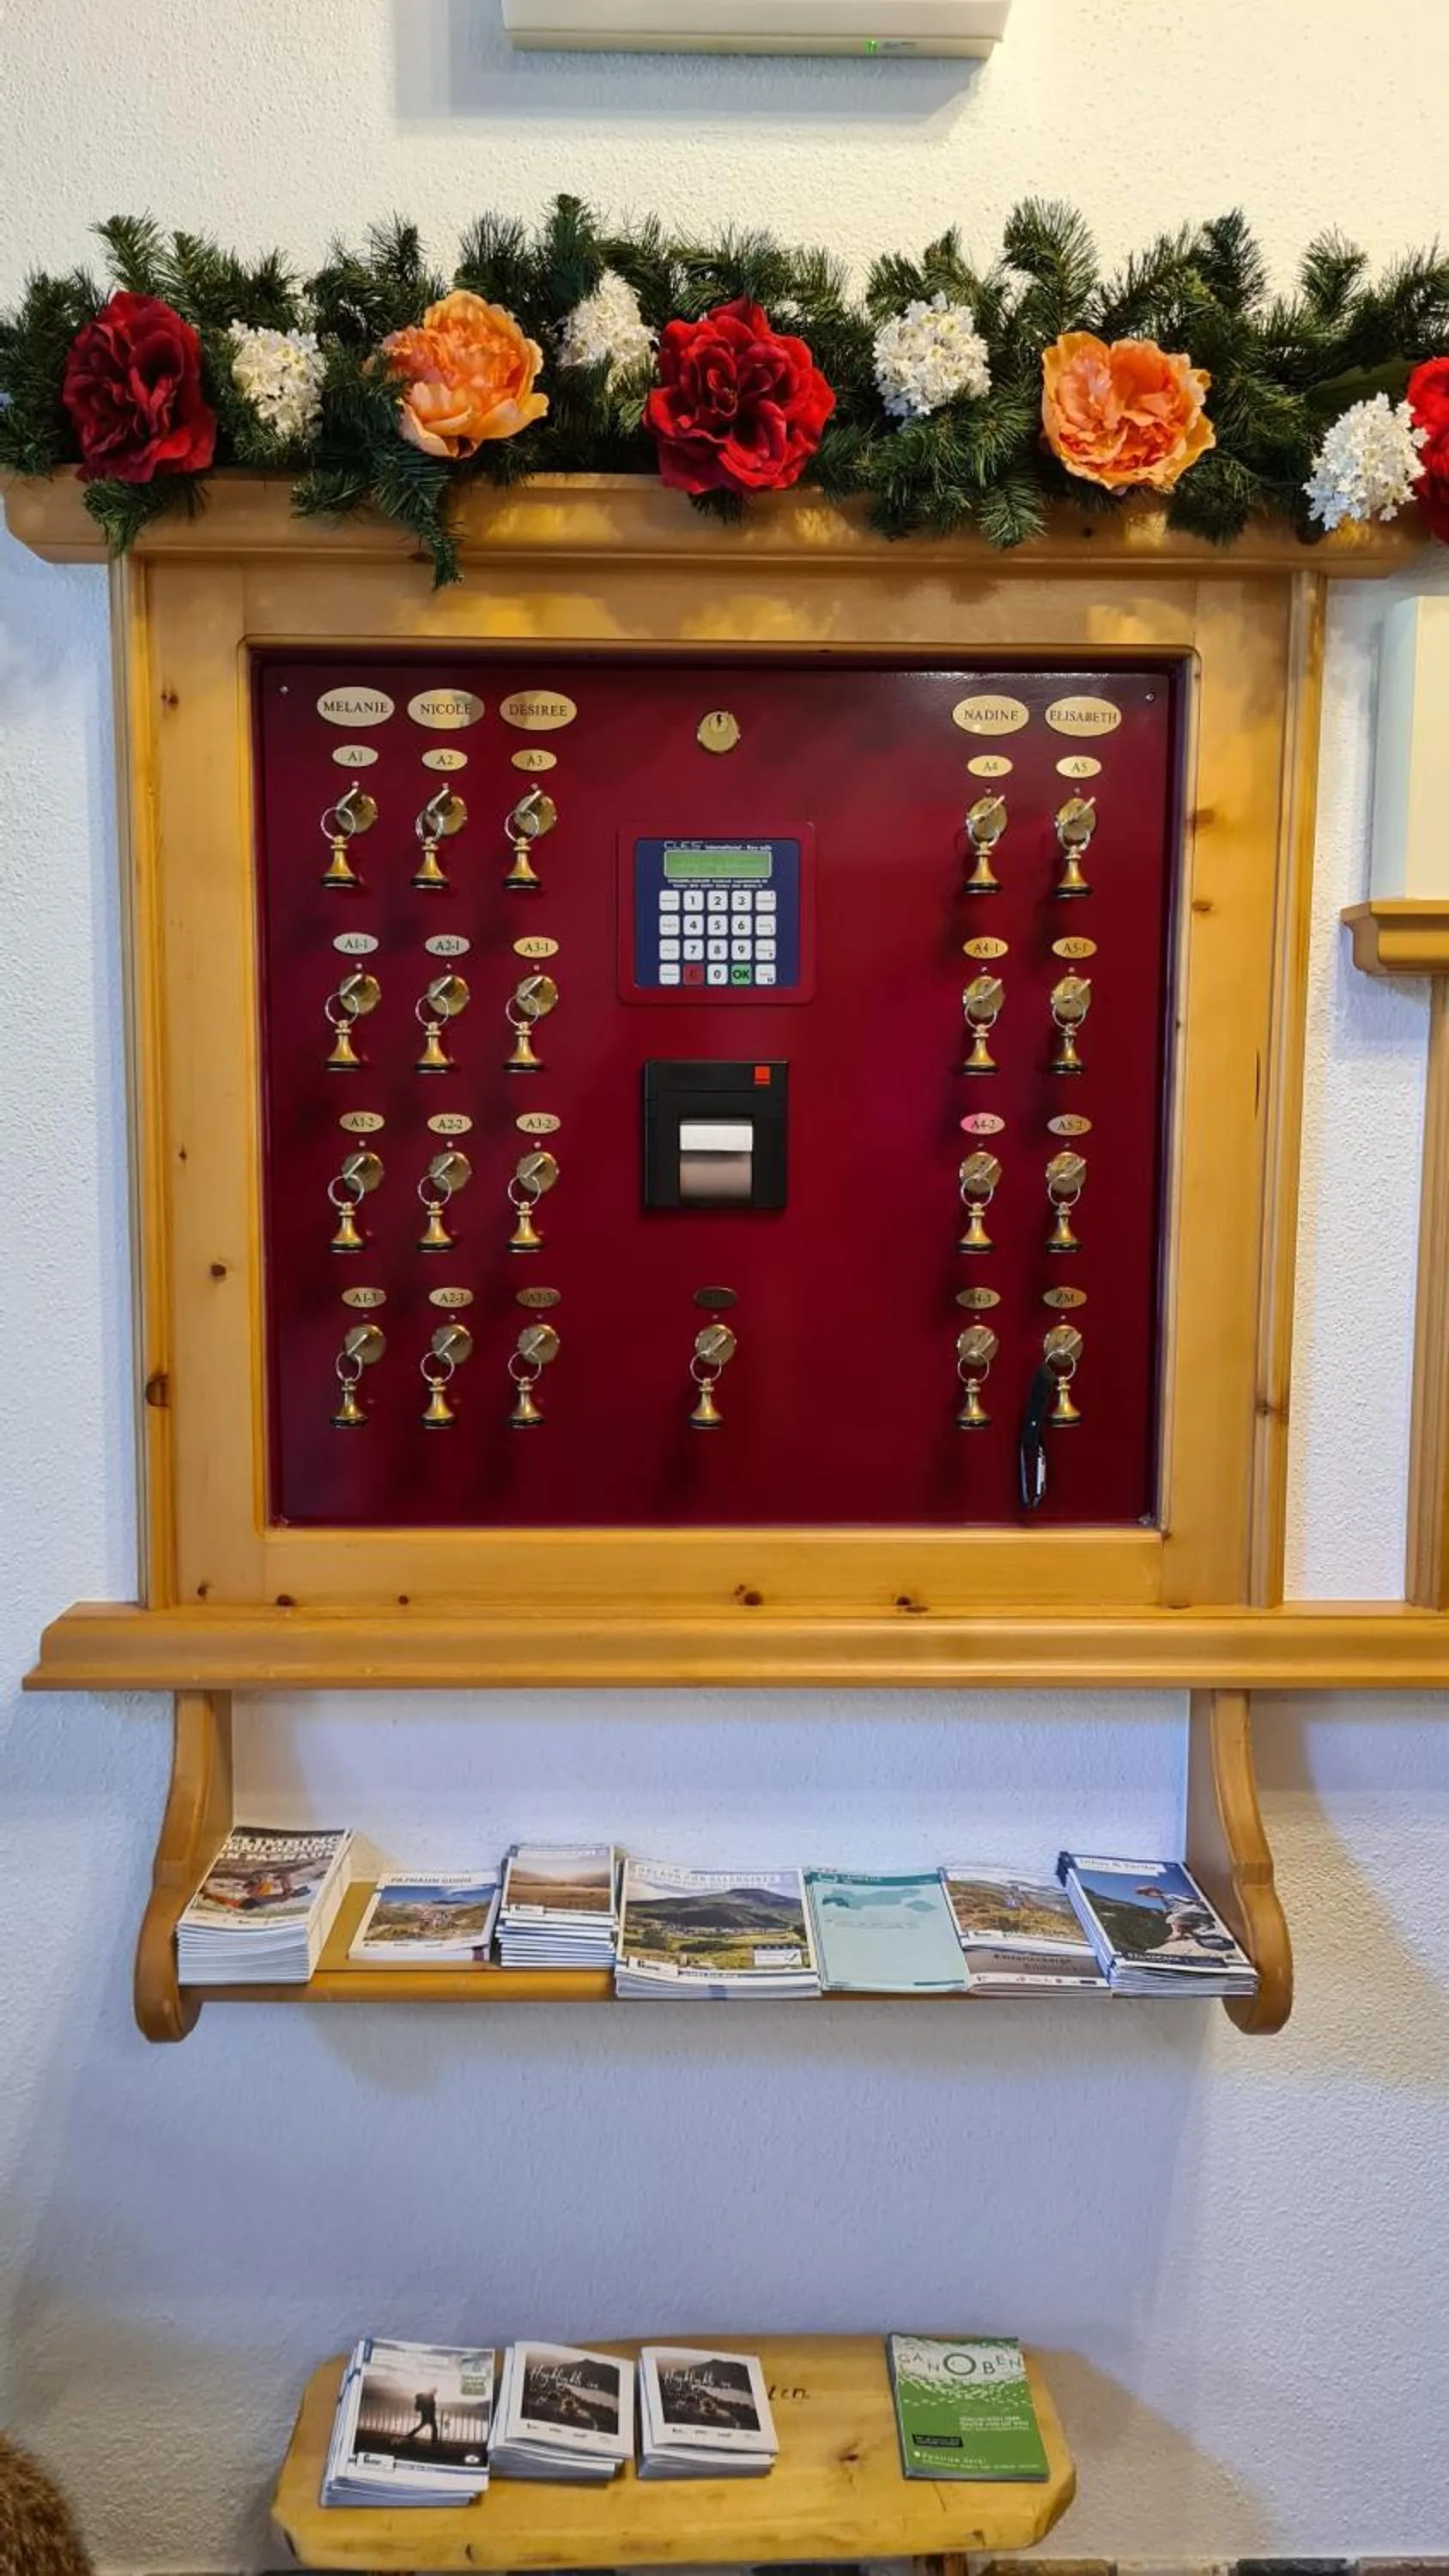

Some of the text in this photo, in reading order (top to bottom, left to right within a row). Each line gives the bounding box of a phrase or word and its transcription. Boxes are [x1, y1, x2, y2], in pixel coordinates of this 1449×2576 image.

[323, 701, 389, 714] MELANIE
[420, 702, 473, 715] NICOLE
[509, 704, 567, 717] DESIREE
[964, 709, 1019, 722] NADINE
[1049, 711, 1117, 725] ELISABETH
[348, 750, 363, 762] A1
[436, 753, 453, 766] A2
[526, 754, 543, 767] A3
[983, 762, 998, 773] A4
[1071, 762, 1088, 774] A5
[689, 896, 695, 905] 1
[714, 896, 722, 906] 2
[738, 896, 746, 906] 3
[689, 920, 745, 930] 4 5 6
[343, 938, 368, 950] A1-1
[434, 940, 460, 951] A2-1
[524, 941, 549, 953] A3-1
[690, 945, 745, 955] 7 8 9
[973, 943, 999, 954] A4-1
[1062, 943, 1088, 954] A5-1
[713, 969, 721, 980] 0
[732, 969, 749, 980] OK
[349, 1116, 375, 1127] A1-2
[437, 1118, 464, 1130] A2-2
[439, 1291, 464, 1303] A2-3
